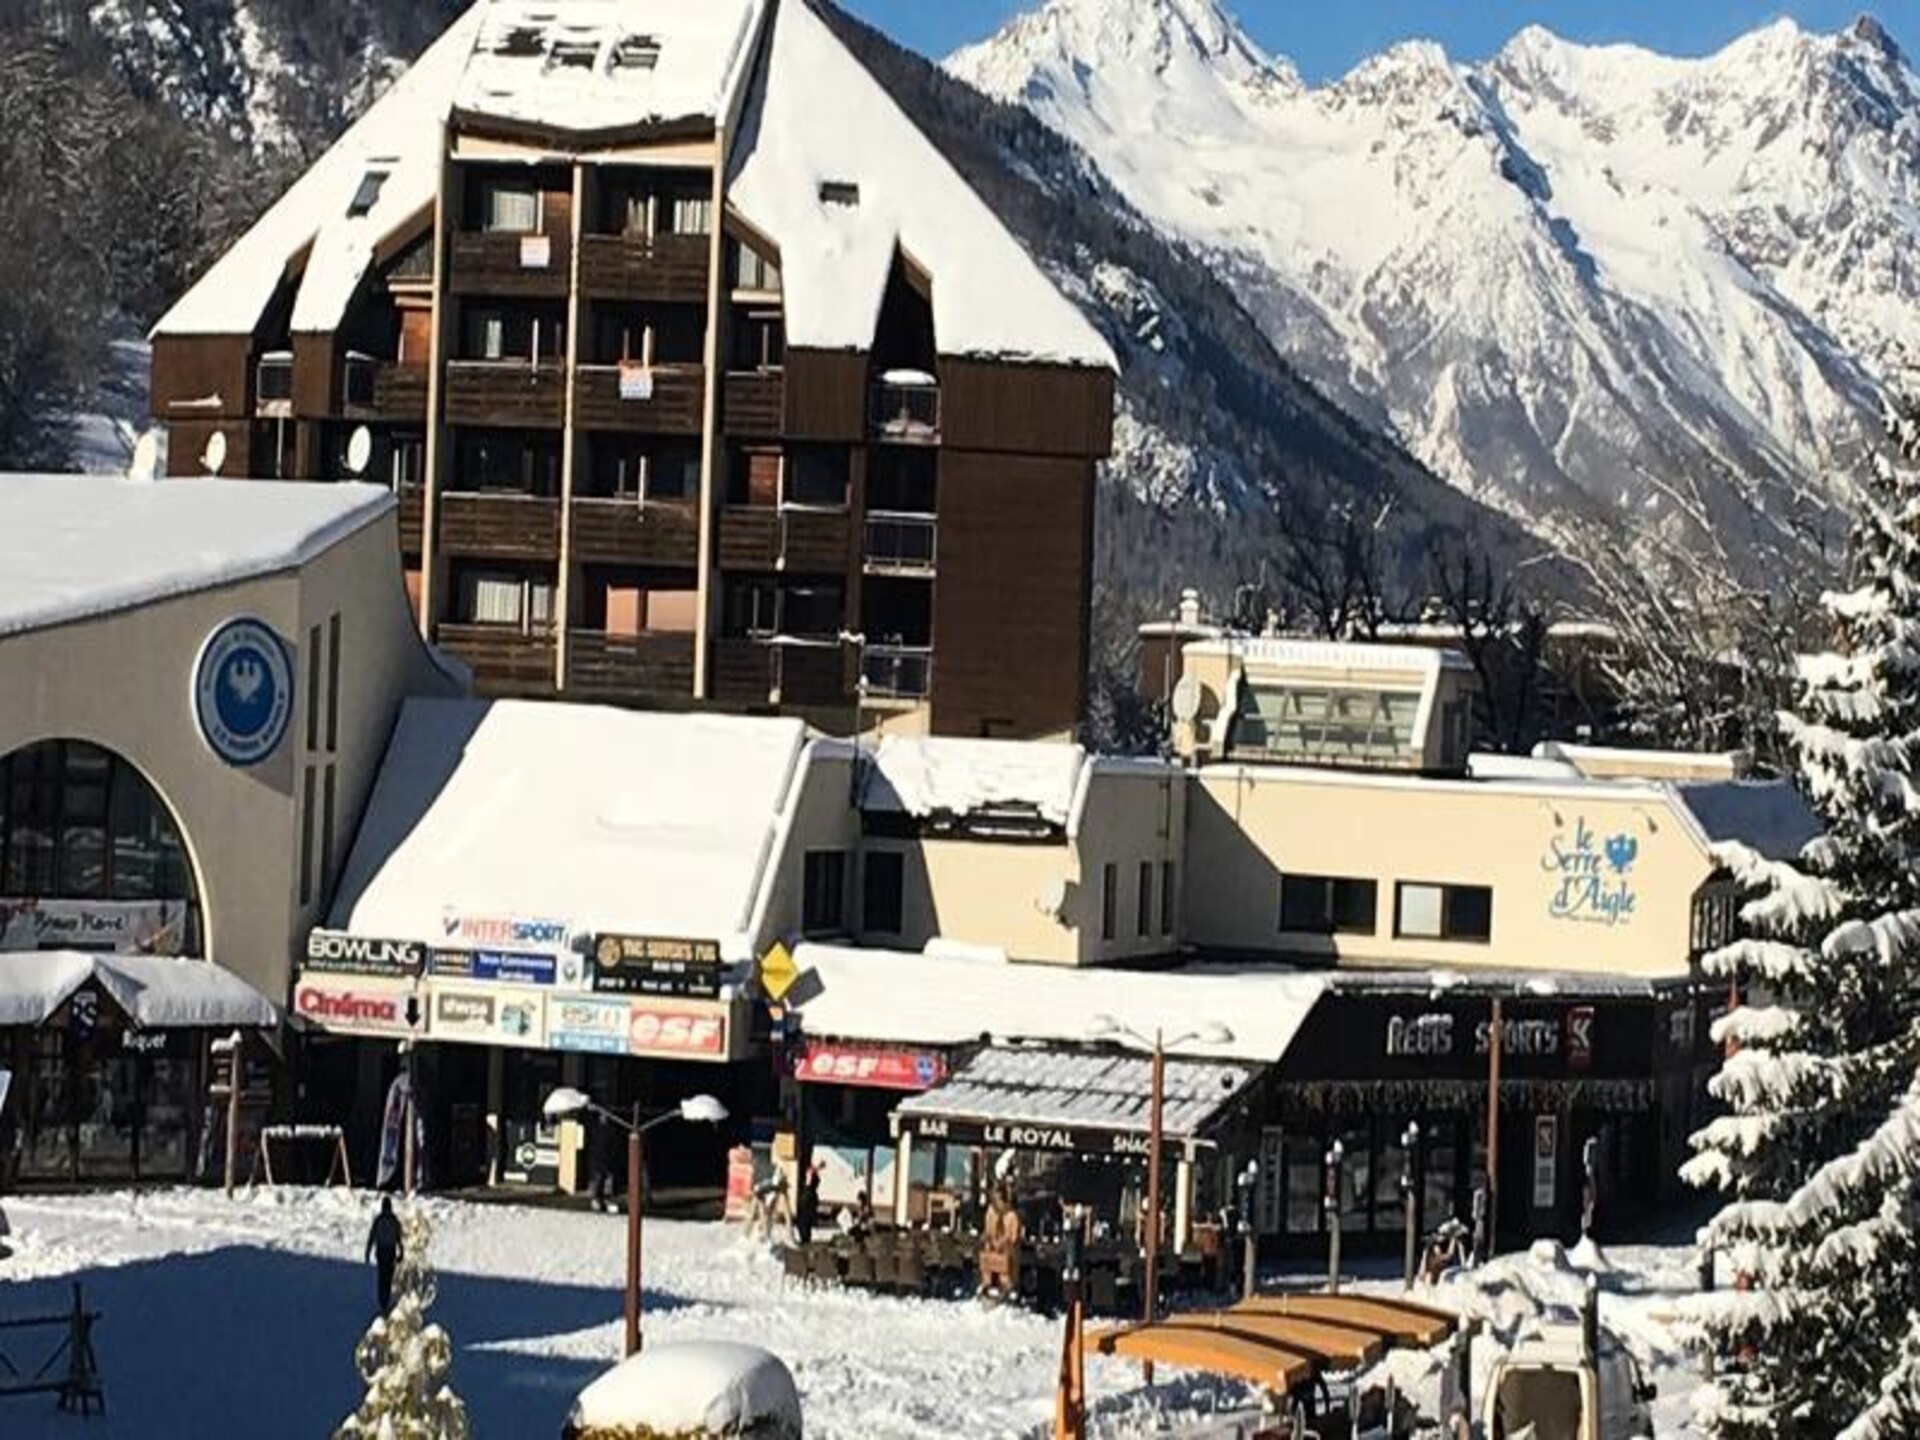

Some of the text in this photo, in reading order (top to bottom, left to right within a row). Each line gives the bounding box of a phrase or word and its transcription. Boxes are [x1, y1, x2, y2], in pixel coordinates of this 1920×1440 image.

[1575, 815, 1594, 850] le
[1541, 835, 1602, 874] Serre
[461, 919, 566, 943] INTERSPORT
[308, 936, 420, 964] BOWLING
[299, 988, 397, 1020] Cinéma
[1386, 1013, 1454, 1056] REGIS
[919, 1119, 948, 1137] BAR
[984, 1124, 1074, 1148] LE ROYAL
[1112, 1135, 1152, 1156] SNAC
